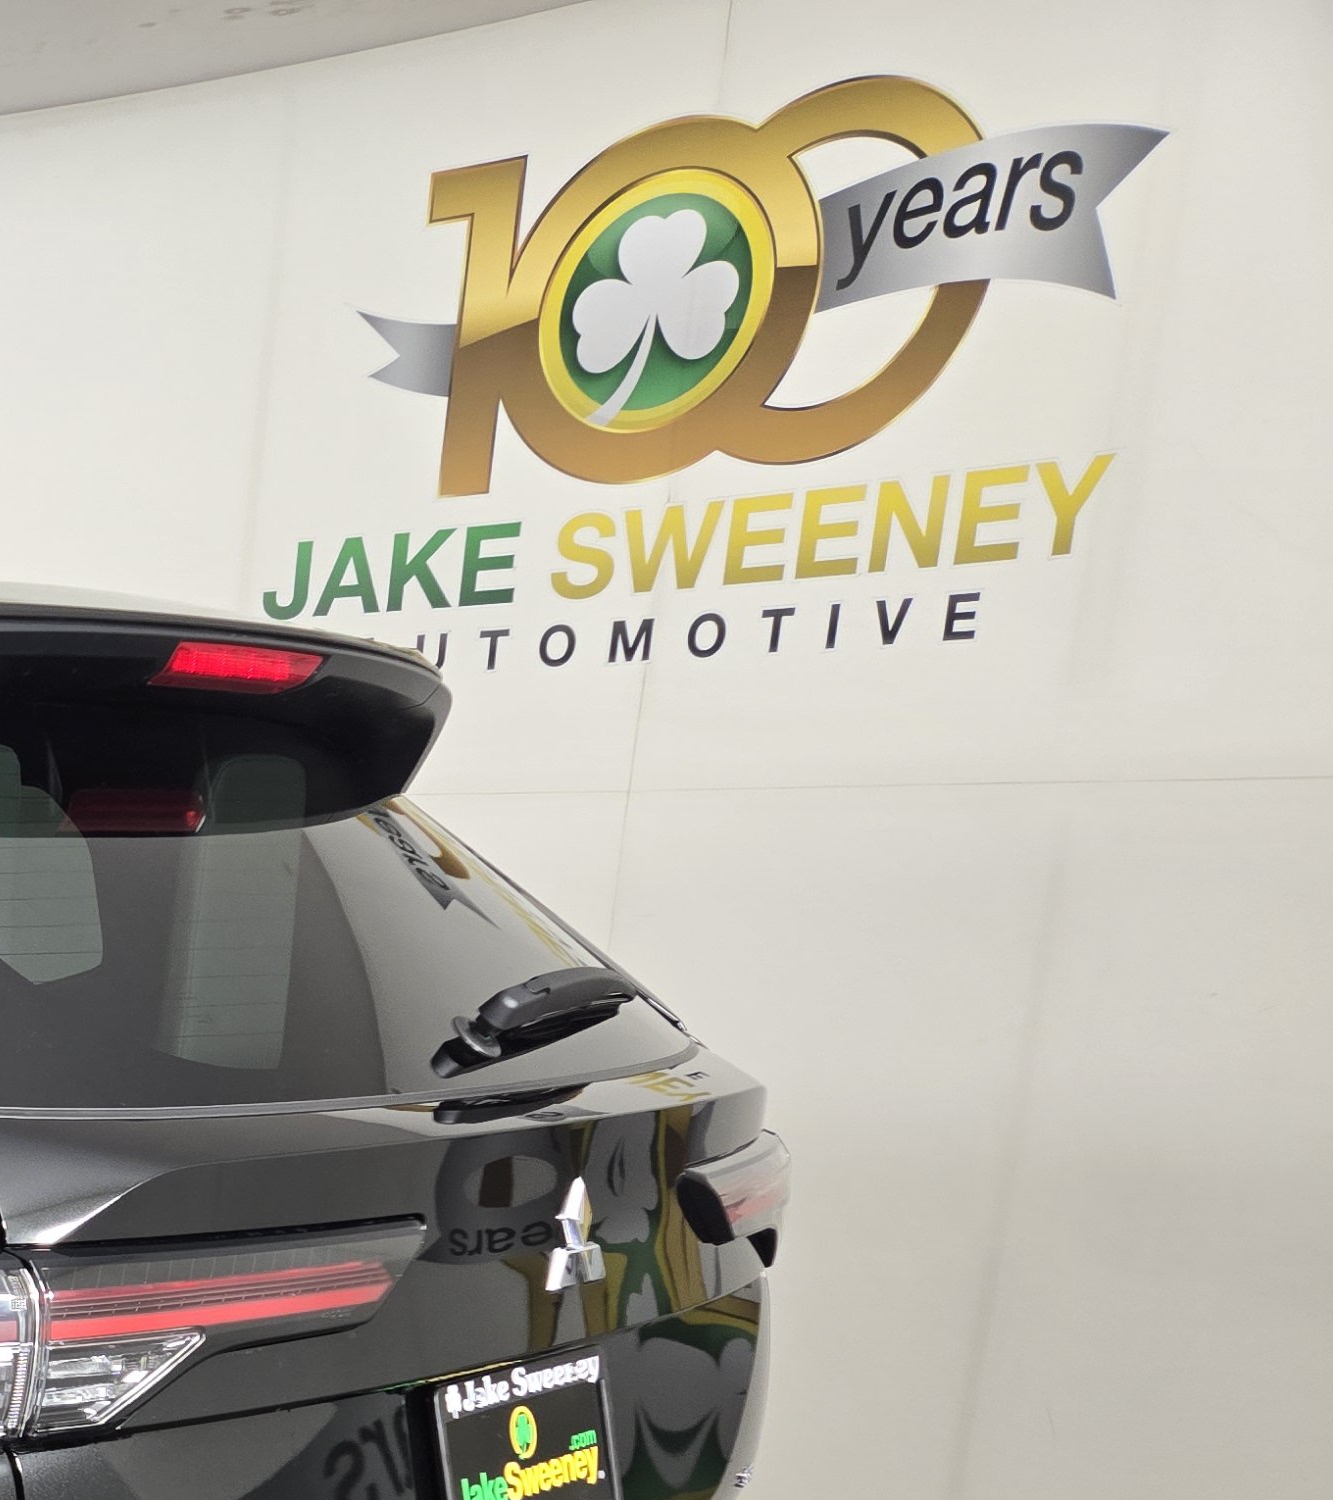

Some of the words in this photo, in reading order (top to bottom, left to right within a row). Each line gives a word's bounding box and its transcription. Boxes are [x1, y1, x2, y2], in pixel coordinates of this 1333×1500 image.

[429, 75, 987, 497] 100
[835, 150, 1084, 290] years
[263, 521, 521, 619] JAKE
[550, 453, 1116, 599] SWEENEY
[365, 591, 981, 670] UTOMOTIVE
[463, 1376, 510, 1411] Jake
[511, 1355, 599, 1396] Sweeney
